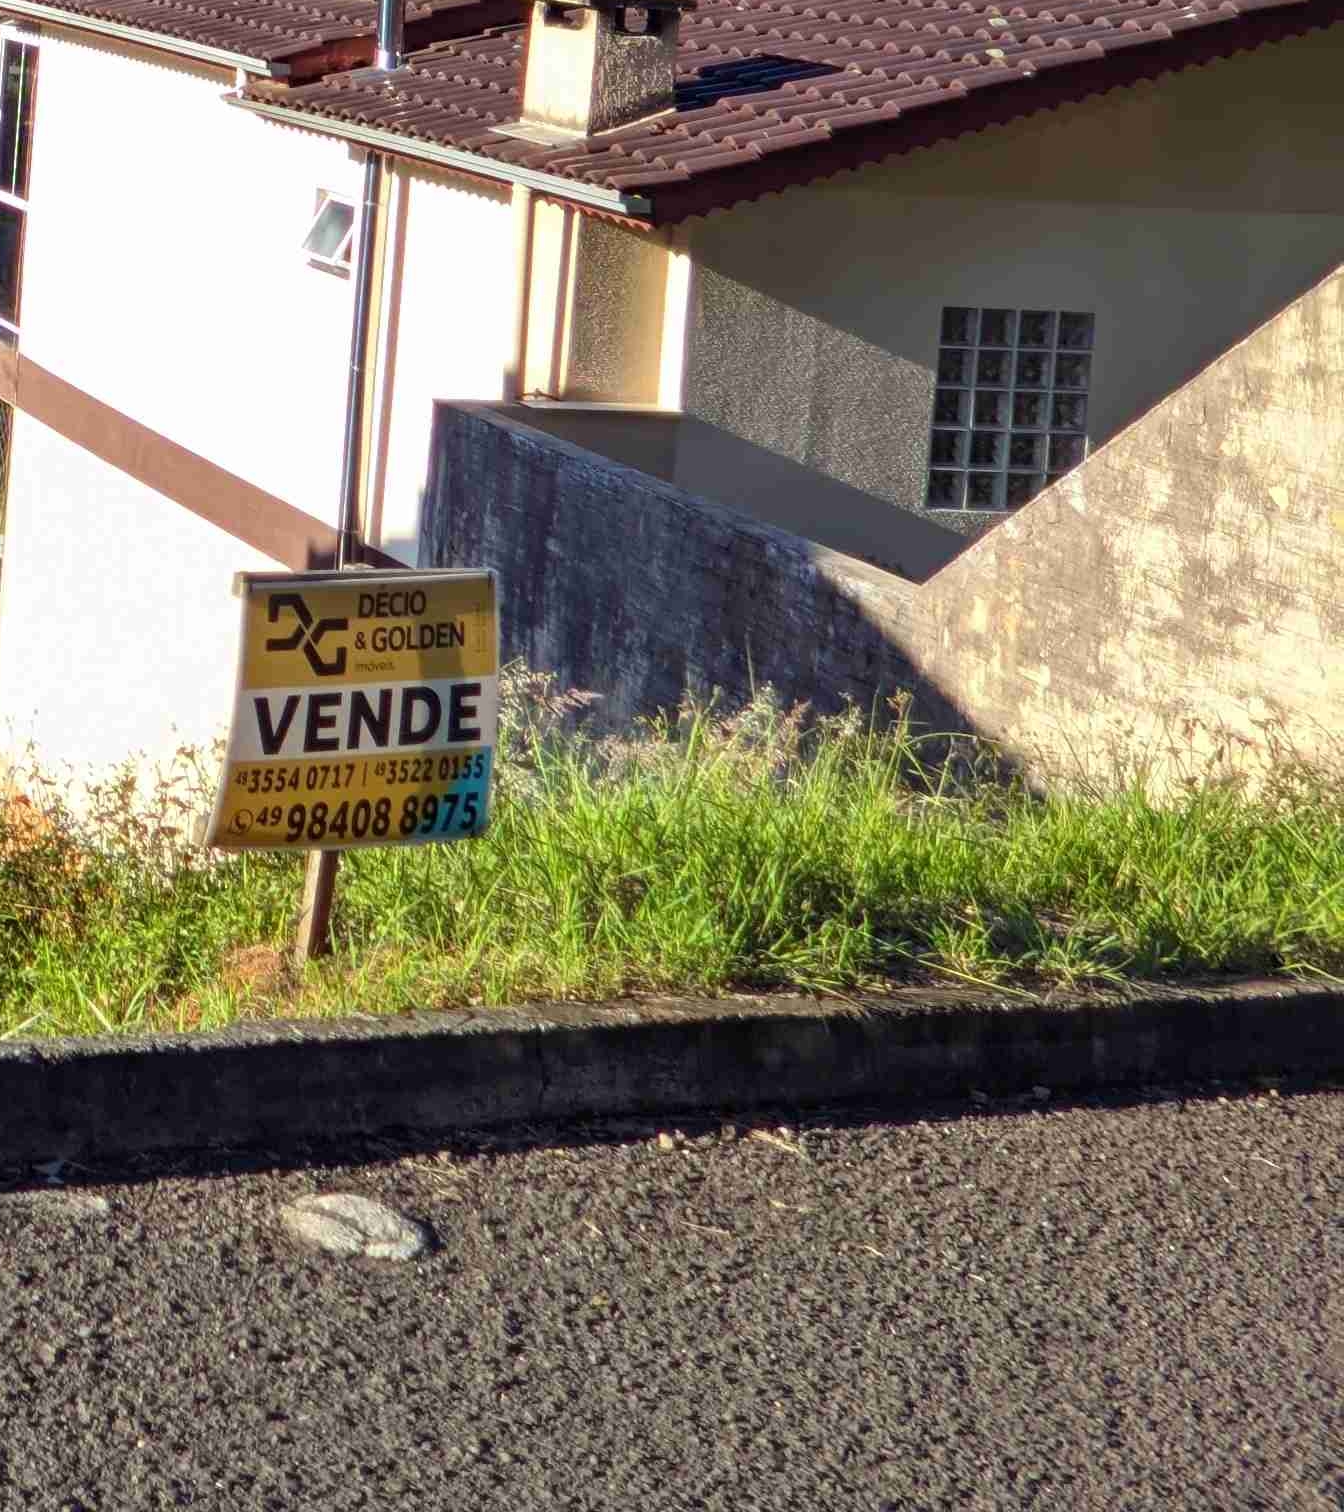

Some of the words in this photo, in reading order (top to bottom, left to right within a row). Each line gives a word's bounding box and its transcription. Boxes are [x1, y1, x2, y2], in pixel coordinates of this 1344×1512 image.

[355, 632, 367, 650] &
[371, 622, 465, 653] GOLDEN
[254, 682, 481, 755] VENDE
[247, 768, 300, 794] 3554
[306, 764, 355, 790] 0717
[385, 757, 433, 785] 3522
[438, 754, 484, 779] 0155
[256, 806, 283, 826] 49
[285, 797, 392, 842] 98408
[399, 791, 479, 836] 8975
